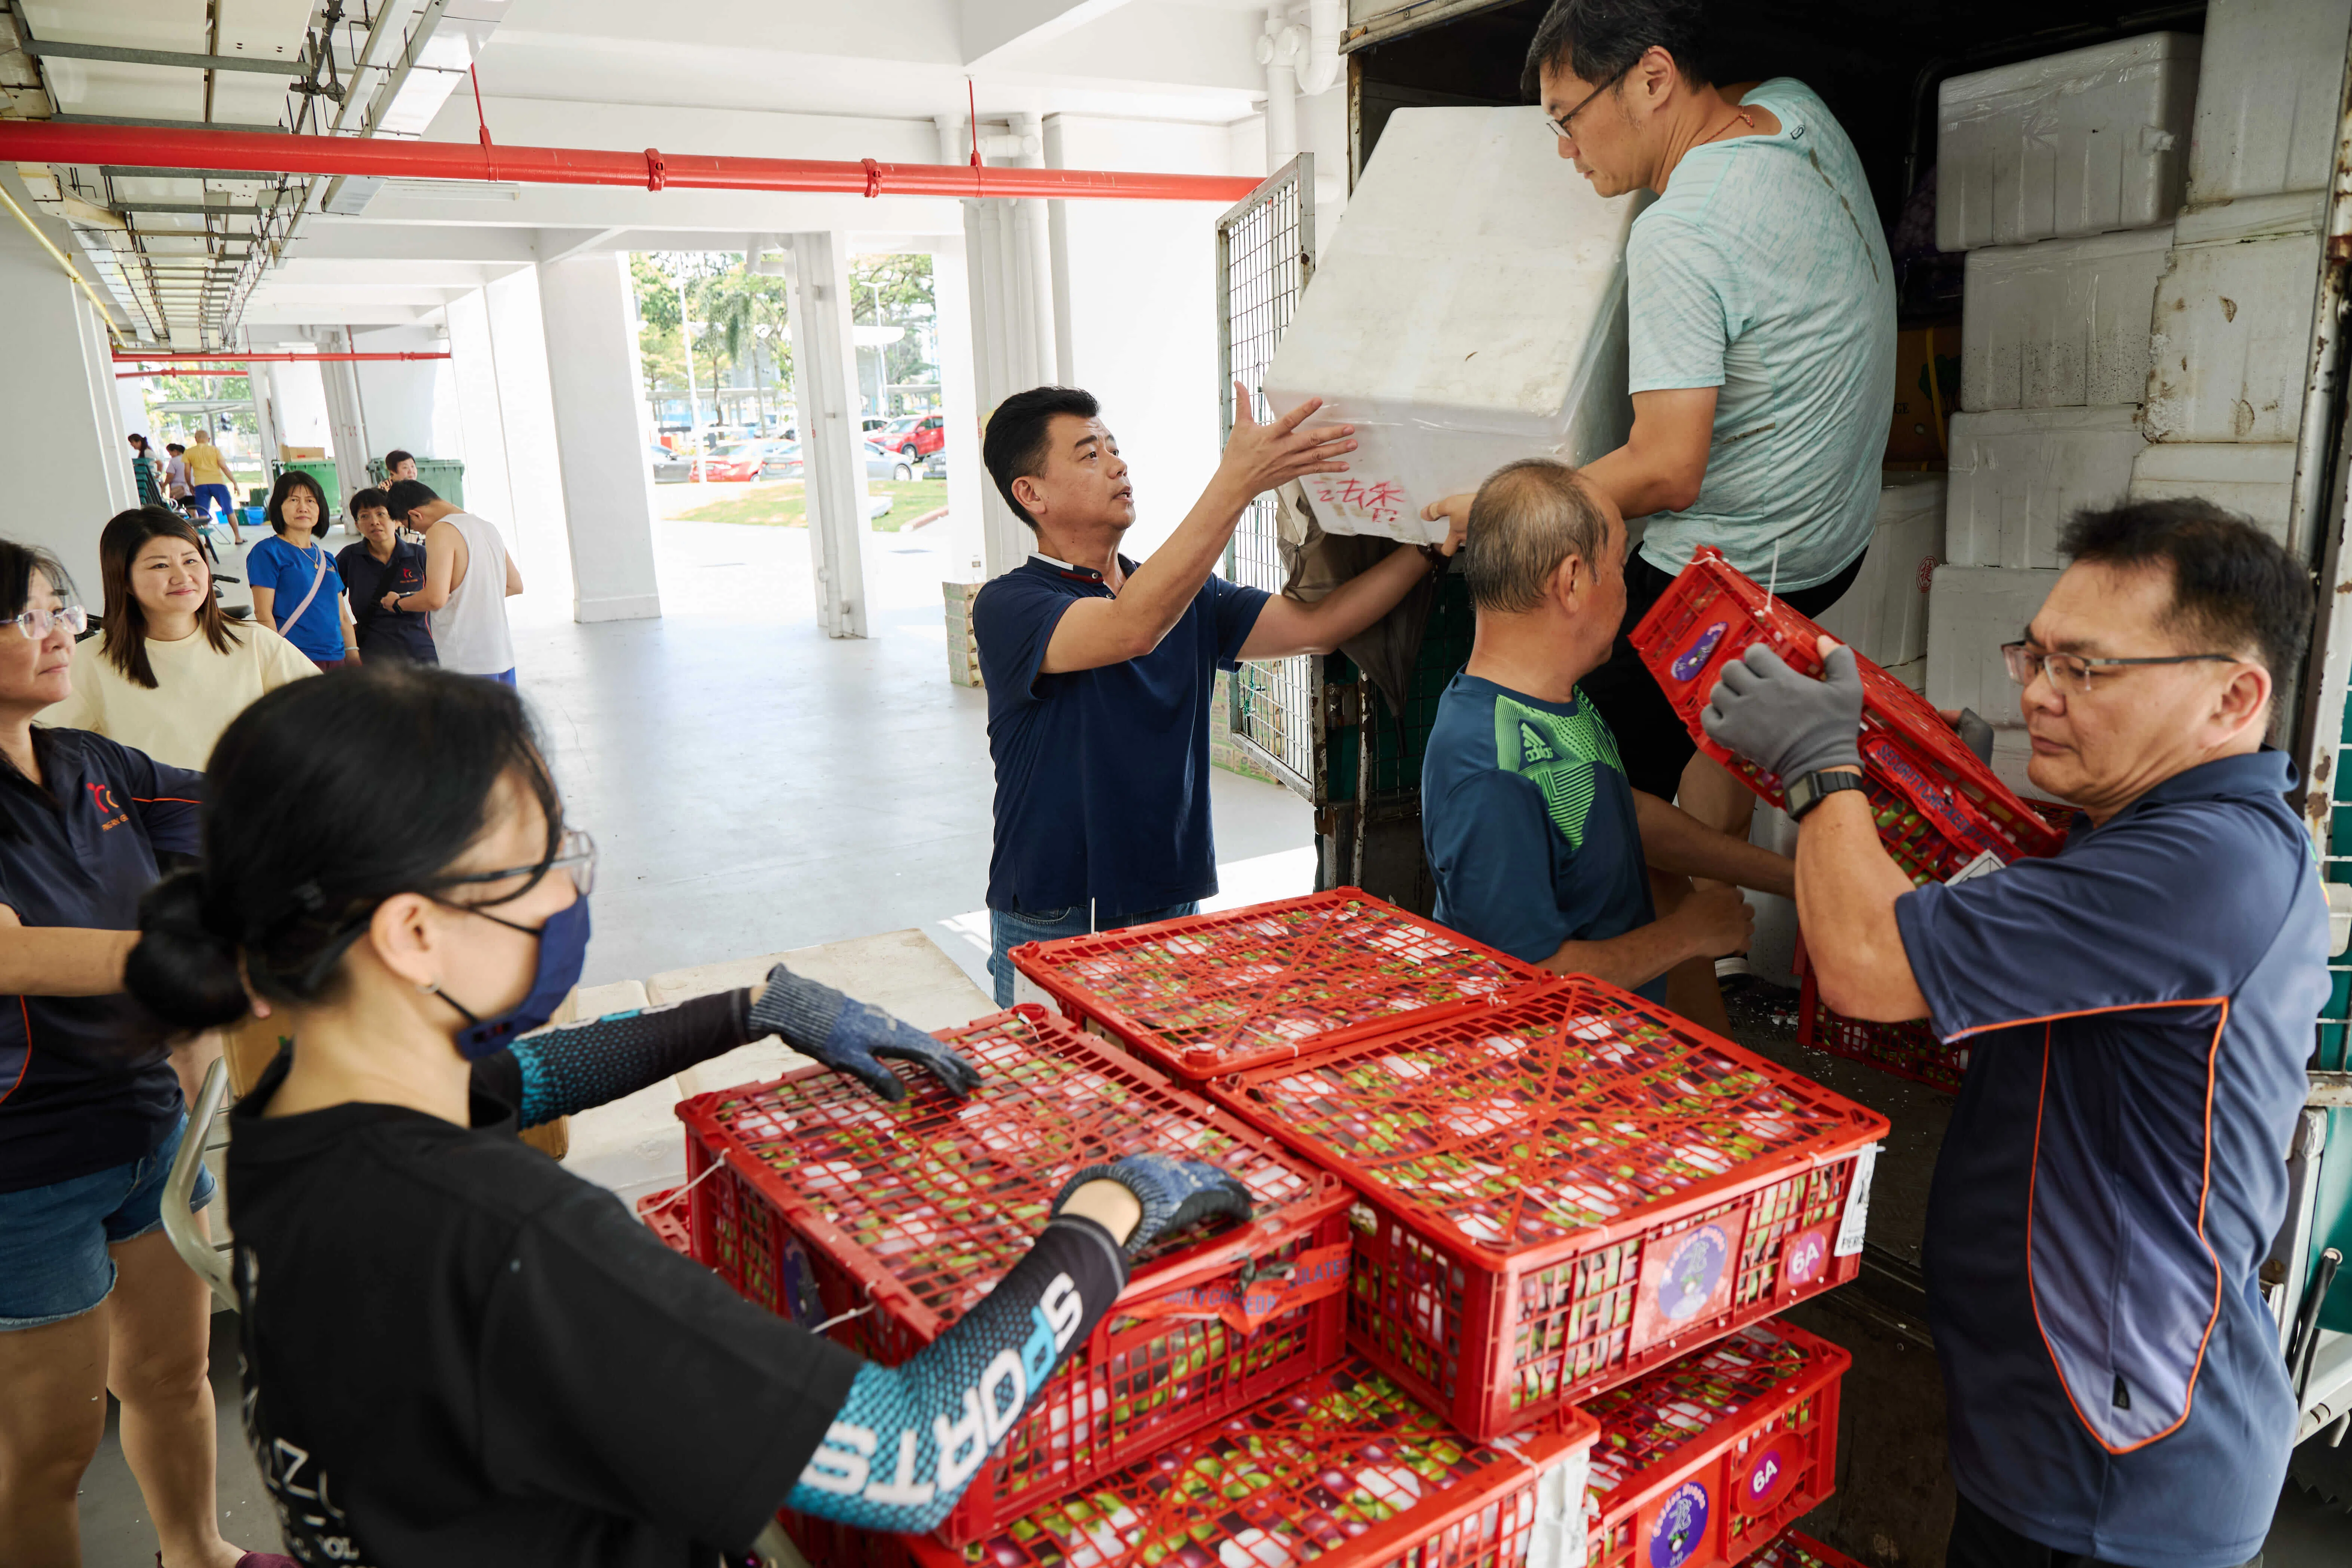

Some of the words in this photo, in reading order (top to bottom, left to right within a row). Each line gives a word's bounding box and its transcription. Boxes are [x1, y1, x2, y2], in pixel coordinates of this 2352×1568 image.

[1525, 745, 1554, 762] adidas
[1876, 744, 1928, 792] SECURITY
[1792, 1241, 1820, 1275] 6A
[798, 1272, 1083, 1508] SPORTS
[1753, 1460, 1778, 1493] 6A
